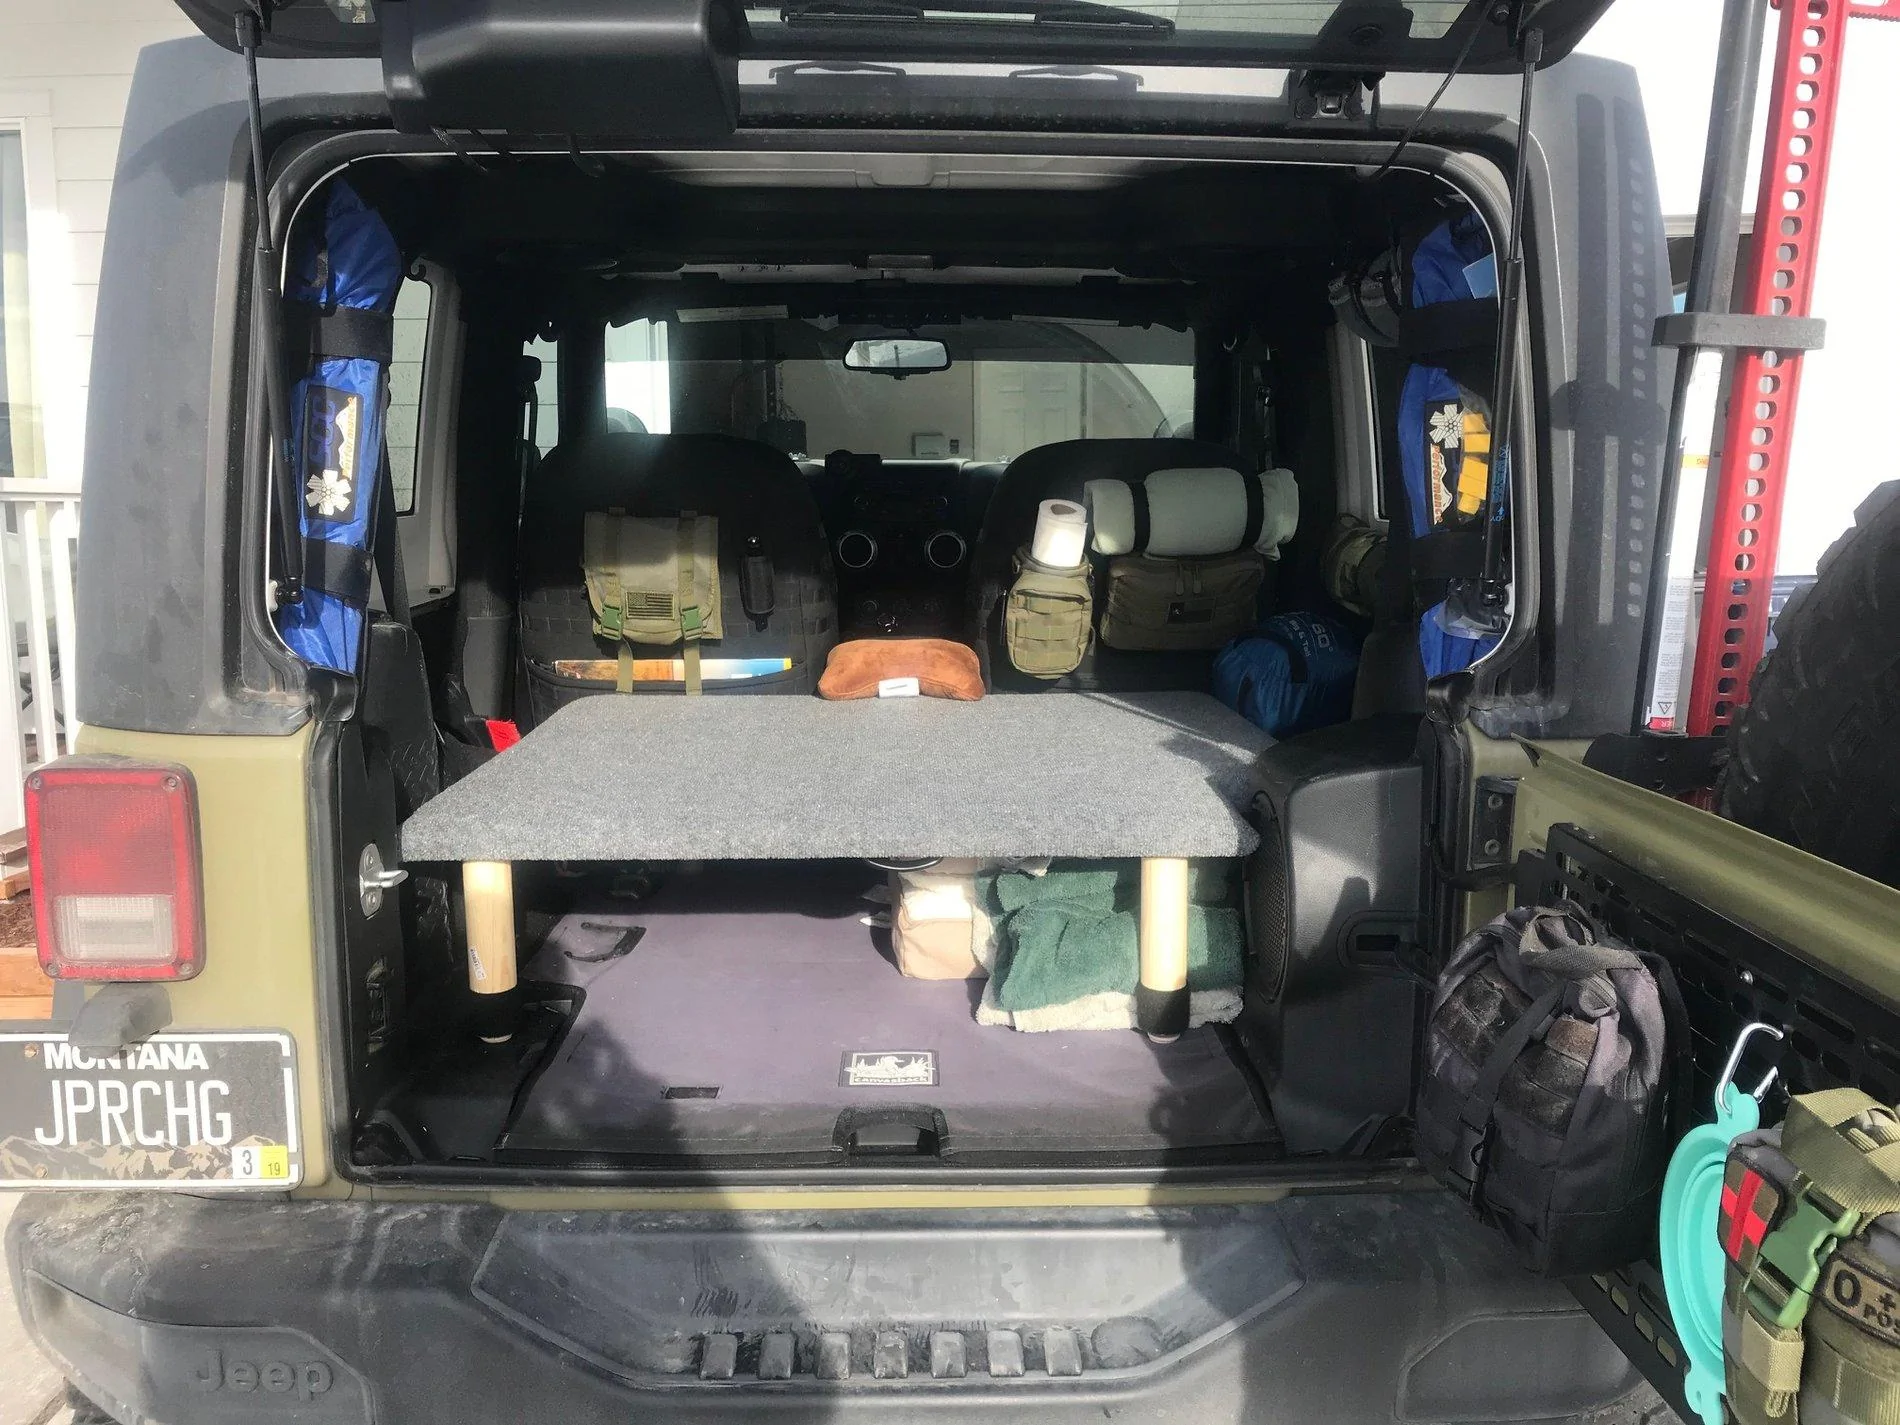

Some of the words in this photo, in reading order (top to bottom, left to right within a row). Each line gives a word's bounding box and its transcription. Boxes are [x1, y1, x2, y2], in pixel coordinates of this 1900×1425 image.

[1432, 444, 1443, 523] Performance
[35, 1080, 232, 1146] JPRCHG
[242, 1150, 252, 1175] 3
[268, 1162, 280, 1176] 19
[196, 1349, 333, 1401] Jeep
